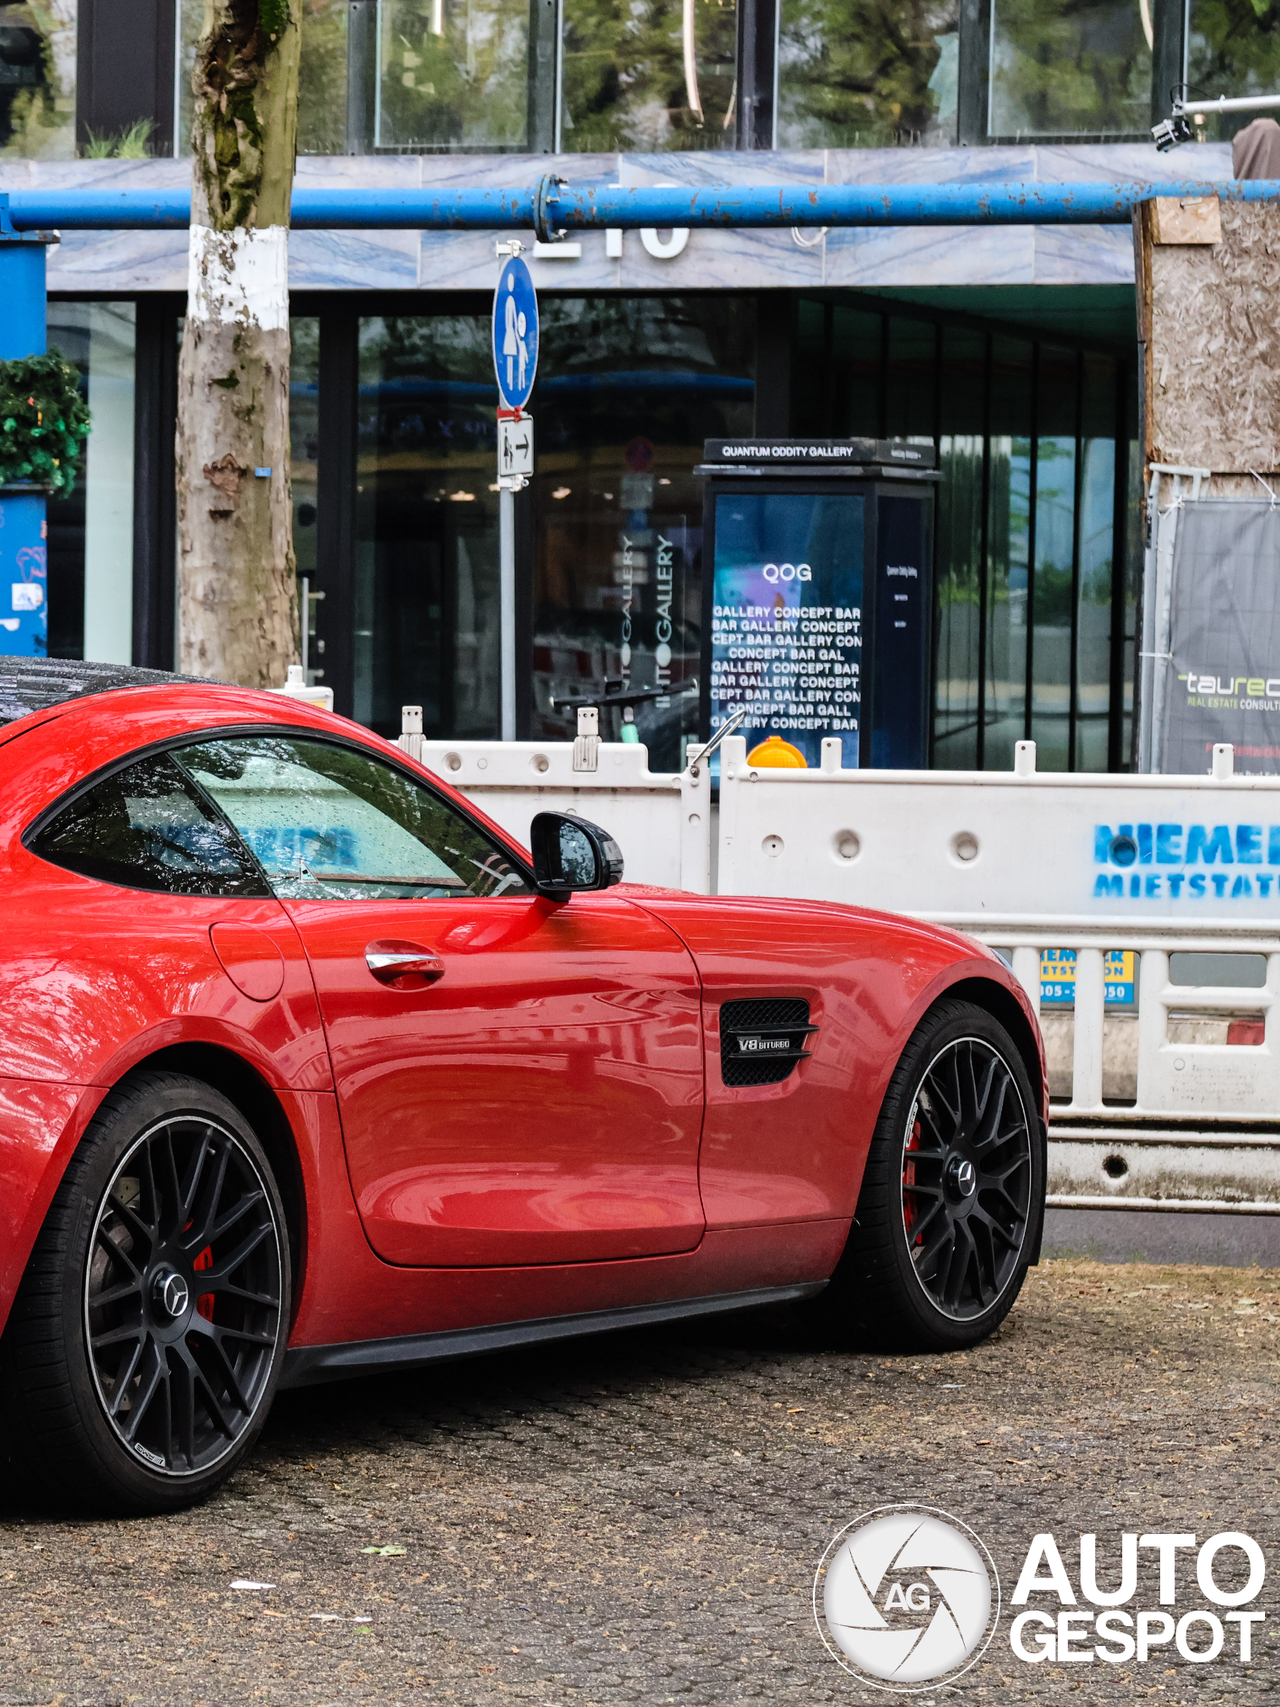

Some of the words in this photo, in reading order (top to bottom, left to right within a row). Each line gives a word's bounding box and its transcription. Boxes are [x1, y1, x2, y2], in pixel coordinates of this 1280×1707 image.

[722, 446, 770, 457] QUANTUM
[772, 446, 808, 457] ODDITY
[809, 446, 853, 457] GALLERY
[762, 563, 812, 584] QOG
[713, 606, 771, 618] GALLERY
[774, 607, 832, 619] CONCEPT
[835, 607, 861, 619] BAR
[712, 620, 737, 631] BAR
[740, 620, 798, 632] GALLERY
[801, 621, 860, 633] CONCEPT
[711, 633, 743, 645] CEPT
[747, 634, 772, 645] BAR
[775, 634, 833, 646] GALLERY
[836, 635, 862, 647] CON
[729, 647, 787, 659] CONCEPT
[790, 648, 815, 660] BAR
[819, 648, 845, 661] GAL
[711, 661, 770, 673] GALLERY
[772, 662, 831, 674] CONCEPT
[834, 663, 860, 675] BAR
[710, 674, 736, 686] BAR
[739, 675, 797, 687] GALLERY
[800, 676, 859, 688] CONCEPT
[710, 688, 742, 700] CEPT
[745, 689, 770, 700] BAR
[773, 690, 832, 702] GALLERY
[834, 690, 861, 703] CON
[727, 702, 786, 714] CONCEPT
[789, 703, 814, 715] BAR
[817, 704, 852, 716] GALL
[1187, 696, 1206, 707] REAL
[1208, 697, 1238, 709] ESTATE
[1240, 698, 1280, 711] CONSULT
[771, 717, 830, 730] CONCEPT
[833, 718, 858, 730] BAR
[738, 1039, 758, 1051] V8
[759, 1040, 790, 1050] BITURBO
